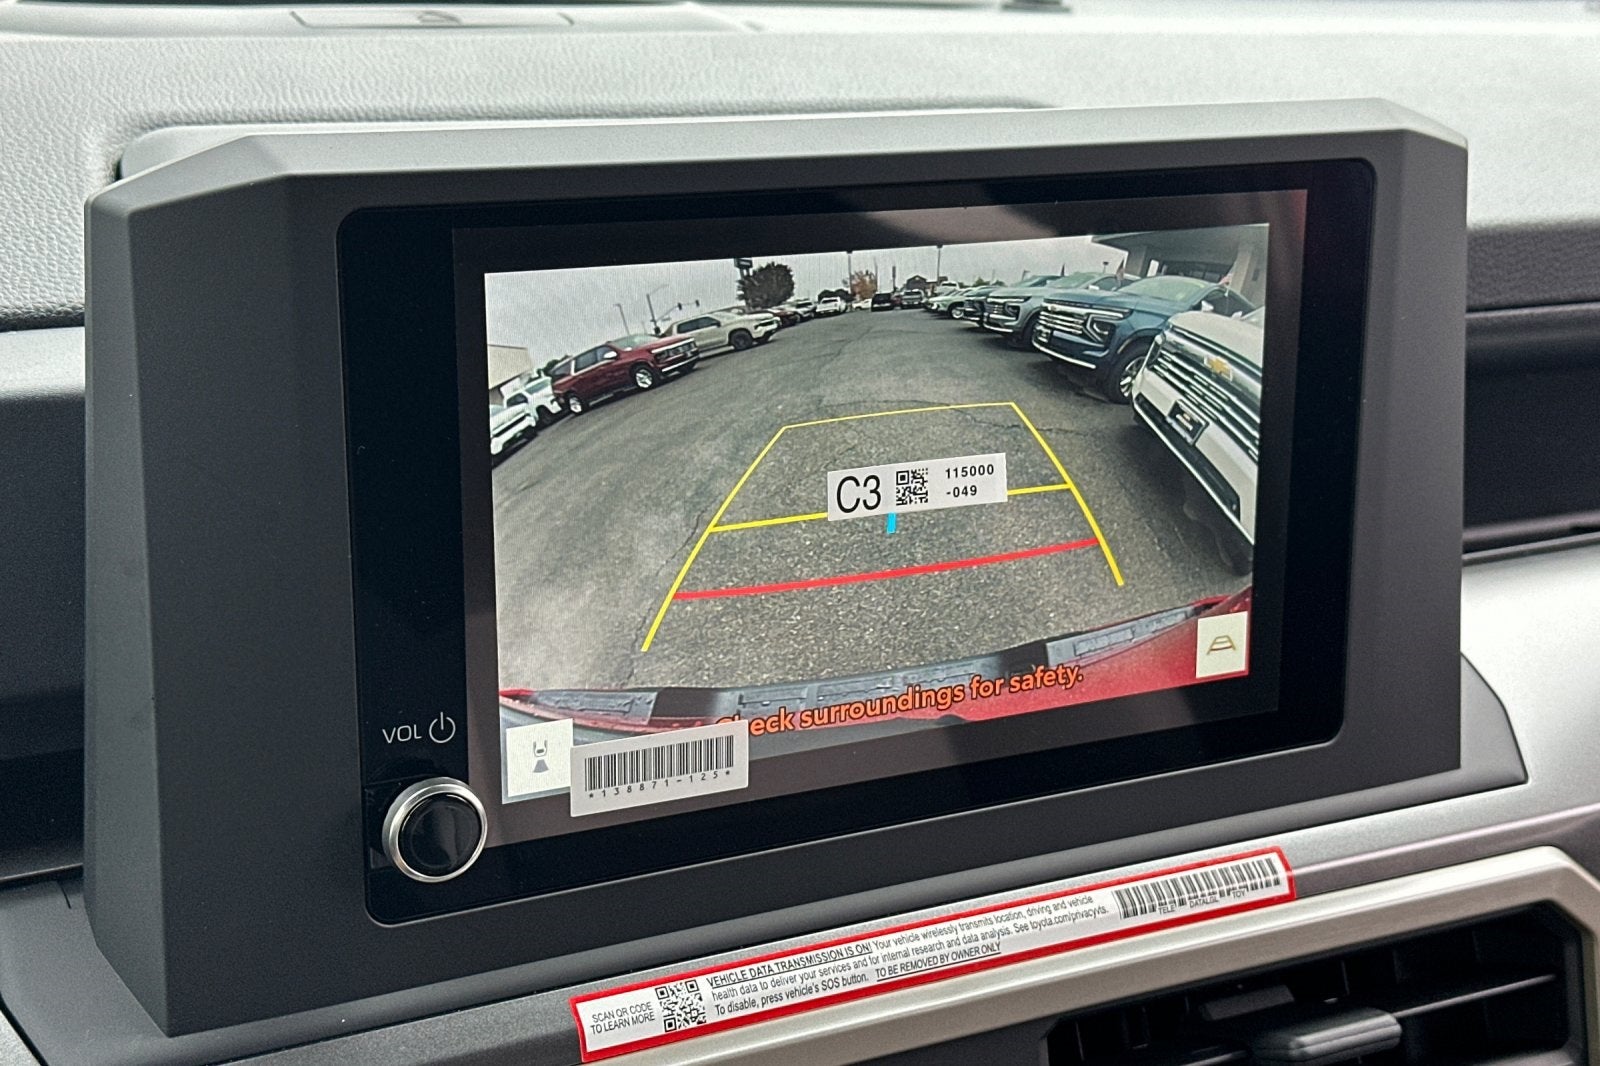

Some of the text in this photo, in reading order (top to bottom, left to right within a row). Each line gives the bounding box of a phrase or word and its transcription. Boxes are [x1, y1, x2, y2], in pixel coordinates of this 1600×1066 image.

[945, 464, 994, 479] 115000
[836, 475, 881, 513] C3
[946, 485, 977, 498] -049
[716, 663, 1084, 737] eck surroundings for safety.
[382, 724, 422, 744] VOL
[1158, 904, 1176, 915] TELE
[706, 895, 1093, 987] VEHICLE DATA TRANSMISSION IS ON! Your vehicle wirelessly transmits location, driving and vehicle
[711, 985, 739, 1001] health
[740, 981, 759, 996] data
[759, 979, 769, 991] to
[770, 972, 798, 988] deliver
[798, 970, 818, 985] your
[819, 962, 851, 978] services
[852, 955, 868, 968] and
[868, 954, 881, 966] for
[881, 947, 911, 962] internal
[912, 938, 946, 956] research
[947, 935, 961, 948] and
[962, 931, 979, 945] data
[980, 925, 1014, 941] analysis.
[1014, 921, 1030, 934] See
[714, 942, 1001, 1016] To disable, press vehicle's SOS button. TO BE REMOVED BY OWNER ONLY
[590, 1012, 655, 1035] TO LEARN MORE
[592, 1002, 653, 1024] SCAN QR CODE
